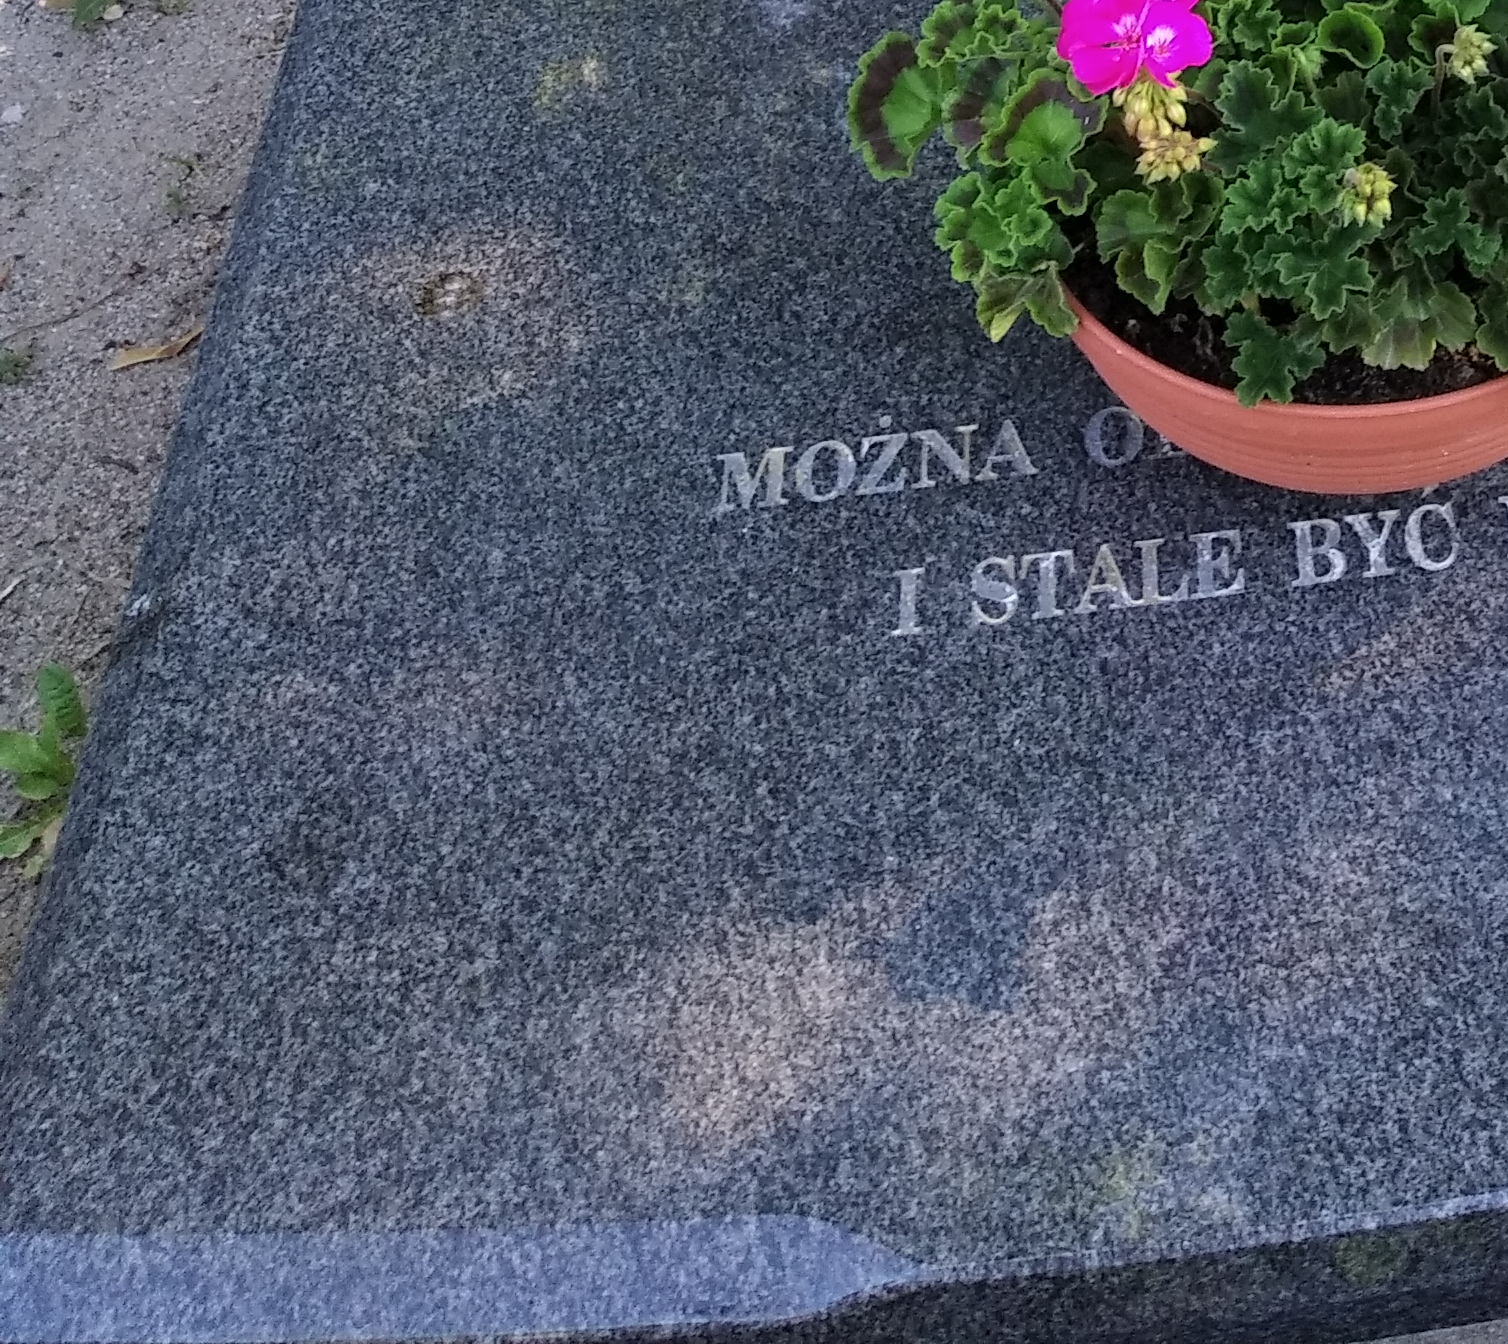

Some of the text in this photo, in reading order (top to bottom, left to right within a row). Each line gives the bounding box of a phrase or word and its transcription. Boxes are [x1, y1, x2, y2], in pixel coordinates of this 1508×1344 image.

[715, 414, 1038, 513] MOŻNA
[891, 566, 927, 637] I
[970, 529, 1247, 625] STALE
